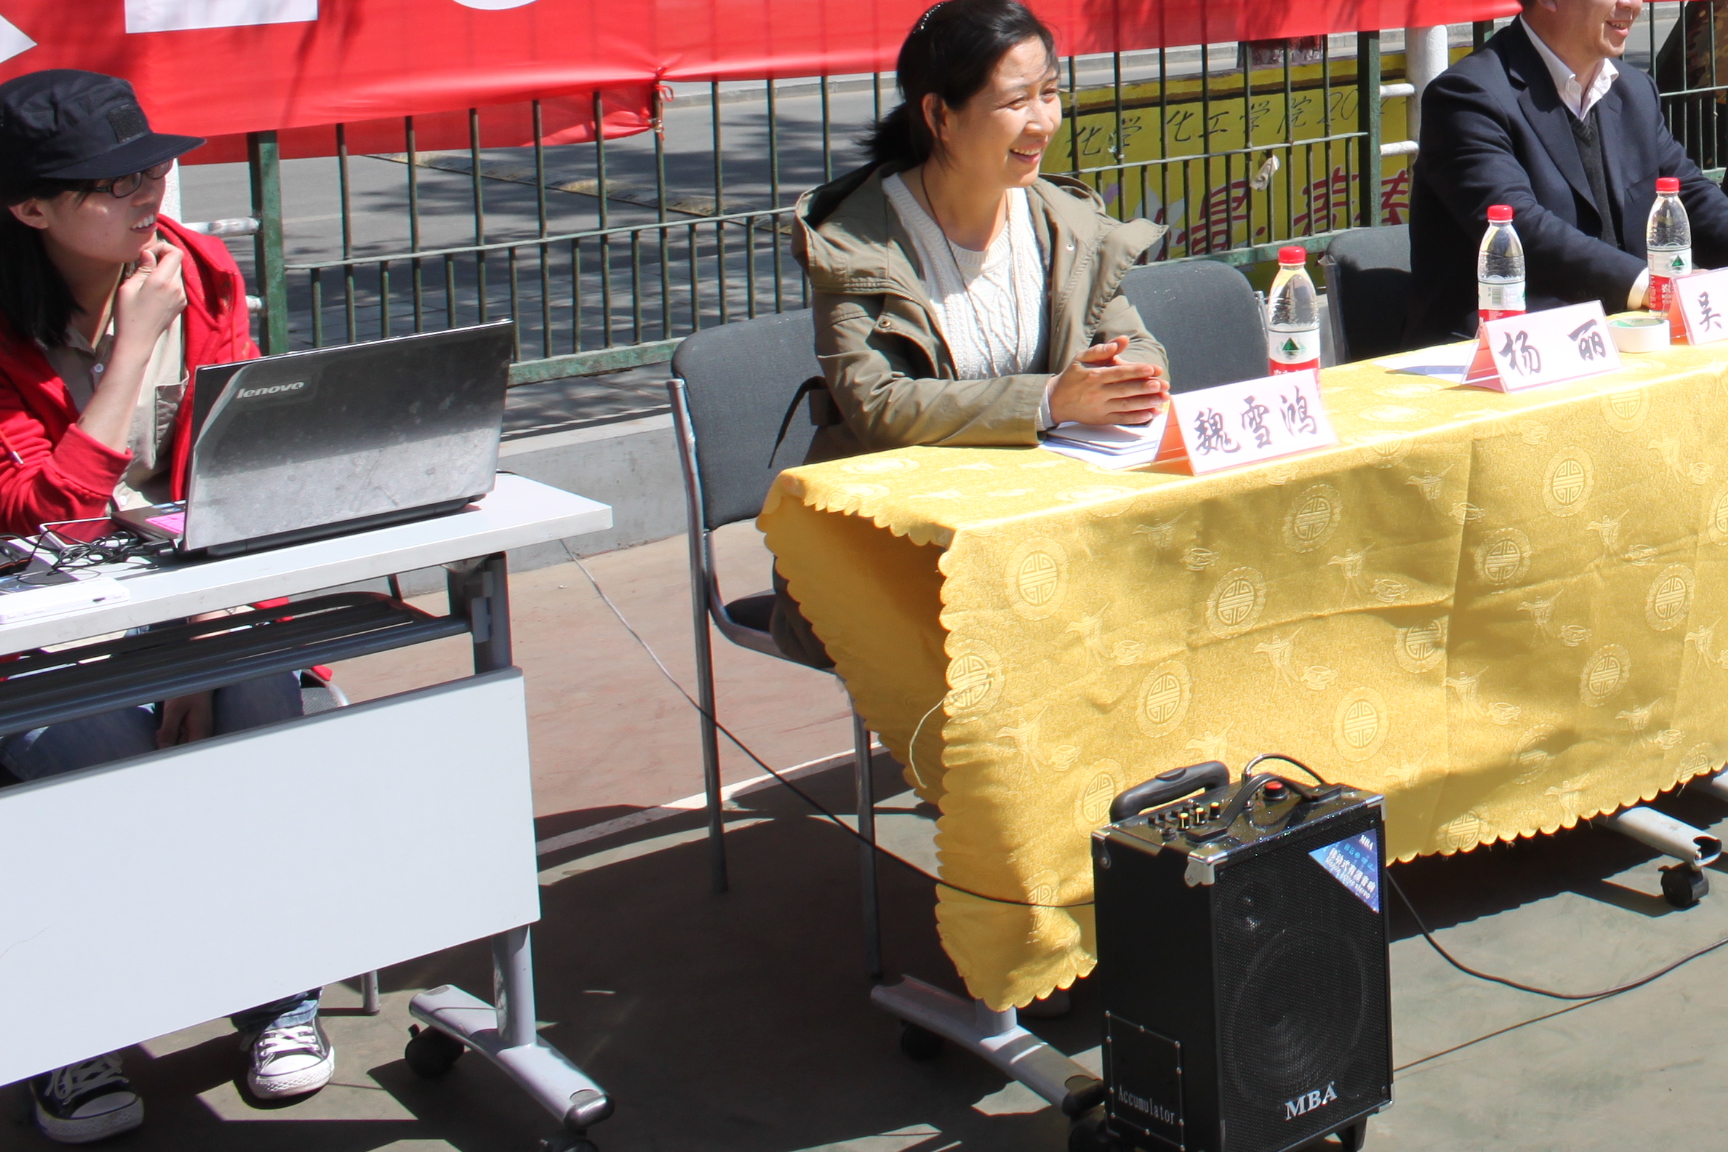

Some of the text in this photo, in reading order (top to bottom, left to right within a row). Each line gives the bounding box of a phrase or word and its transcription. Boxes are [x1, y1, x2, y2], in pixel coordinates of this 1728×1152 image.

[236, 381, 305, 399] lenovo
[1193, 385, 1318, 456] 魏雪鸿
[1118, 1084, 1176, 1126] Accumulator
[1285, 1082, 1338, 1121] MBA
